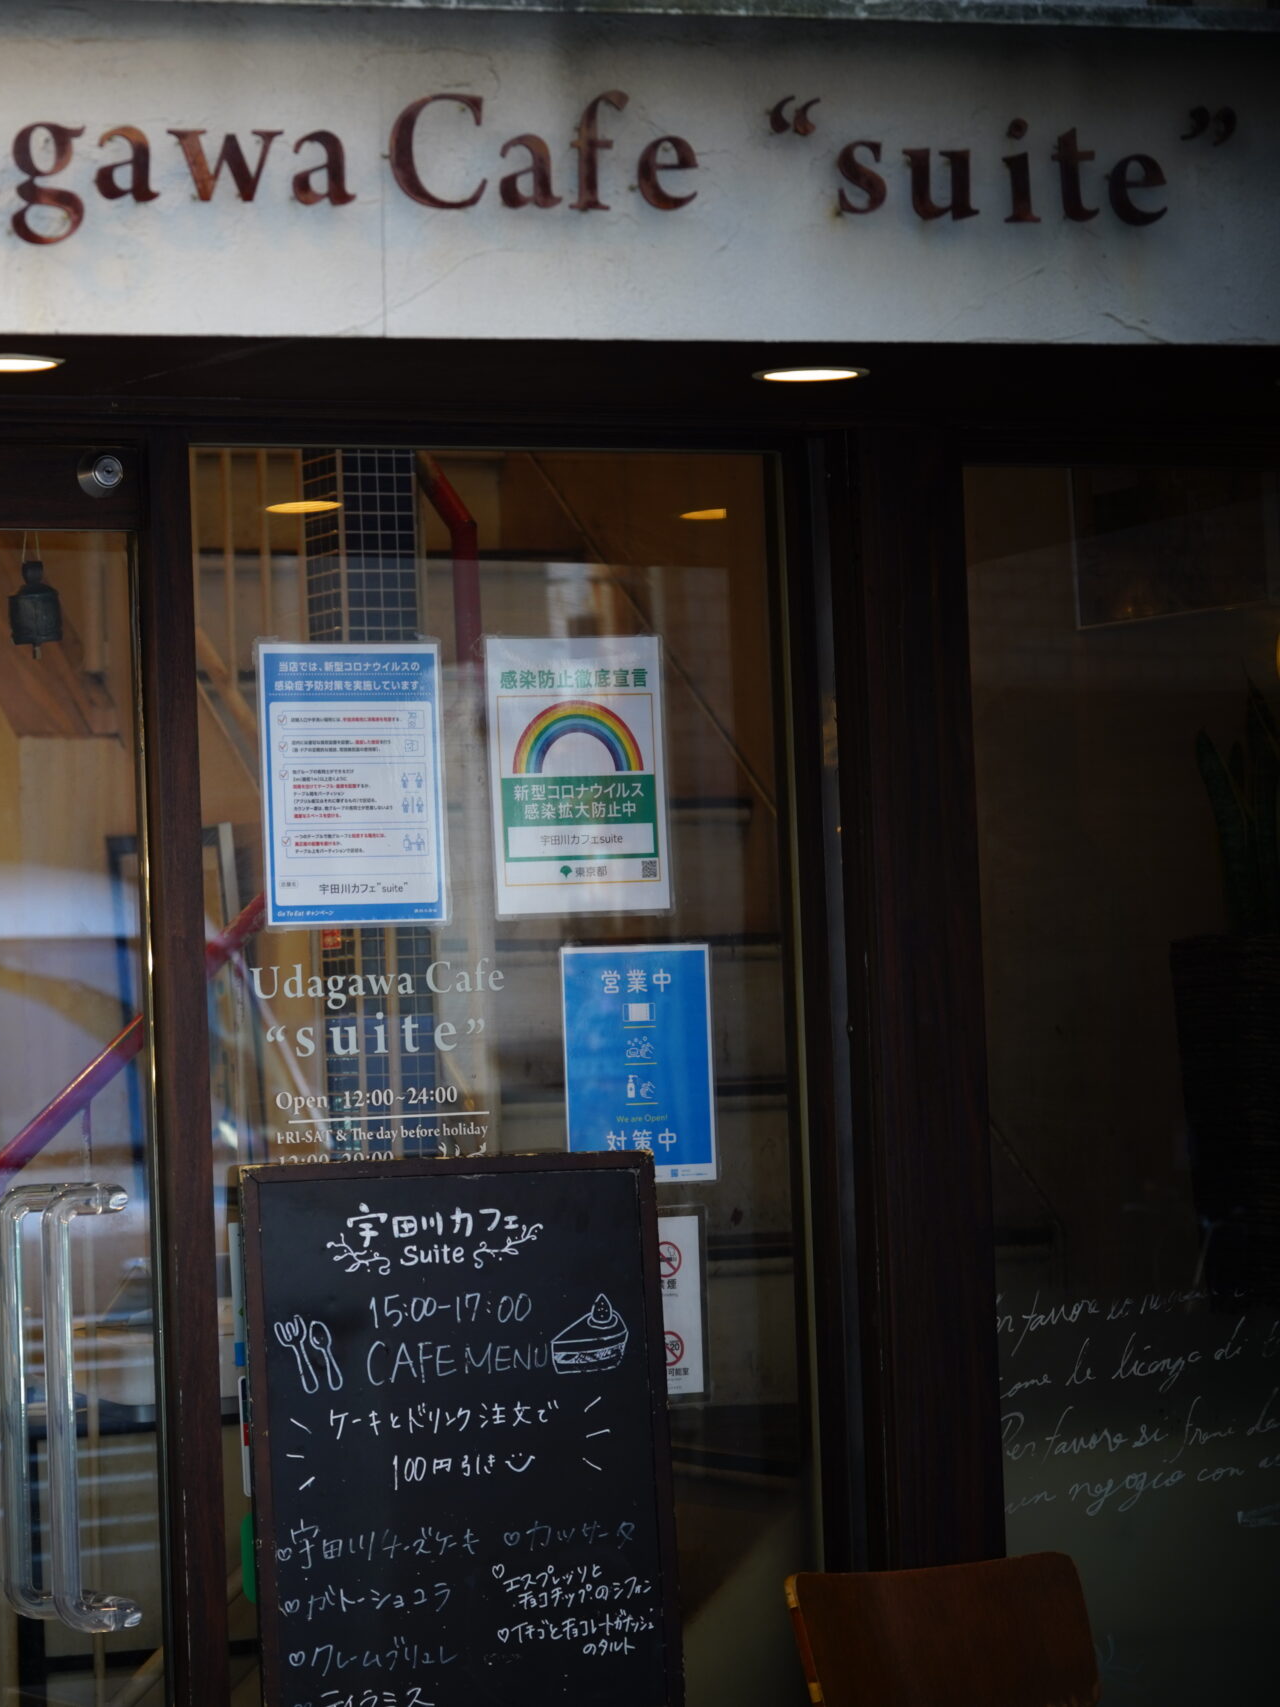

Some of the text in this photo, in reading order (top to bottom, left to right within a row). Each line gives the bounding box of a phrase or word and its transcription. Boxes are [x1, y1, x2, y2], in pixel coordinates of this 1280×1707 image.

[389, 89, 699, 211] Cafe
[500, 668, 648, 689] 感染防止徹底宣言
[514, 782, 645, 802] 新型コロナウイルス
[524, 801, 637, 820] 感染拡大防止中
[575, 866, 608, 878] 東京都
[250, 957, 505, 1009] Udagawa Cafe
[601, 968, 672, 995] 営業中
[276, 1091, 328, 1115] Open
[336, 1129, 347, 1142] &
[351, 1128, 374, 1141] The
[376, 1126, 398, 1142] day
[401, 1123, 440, 1139] before
[443, 1121, 488, 1138] holiday
[606, 1128, 677, 1152] 対策中
[346, 1202, 520, 1248] 宇田川カフェ
[400, 1244, 465, 1266] Suite
[366, 1341, 549, 1387] CAFE MENU
